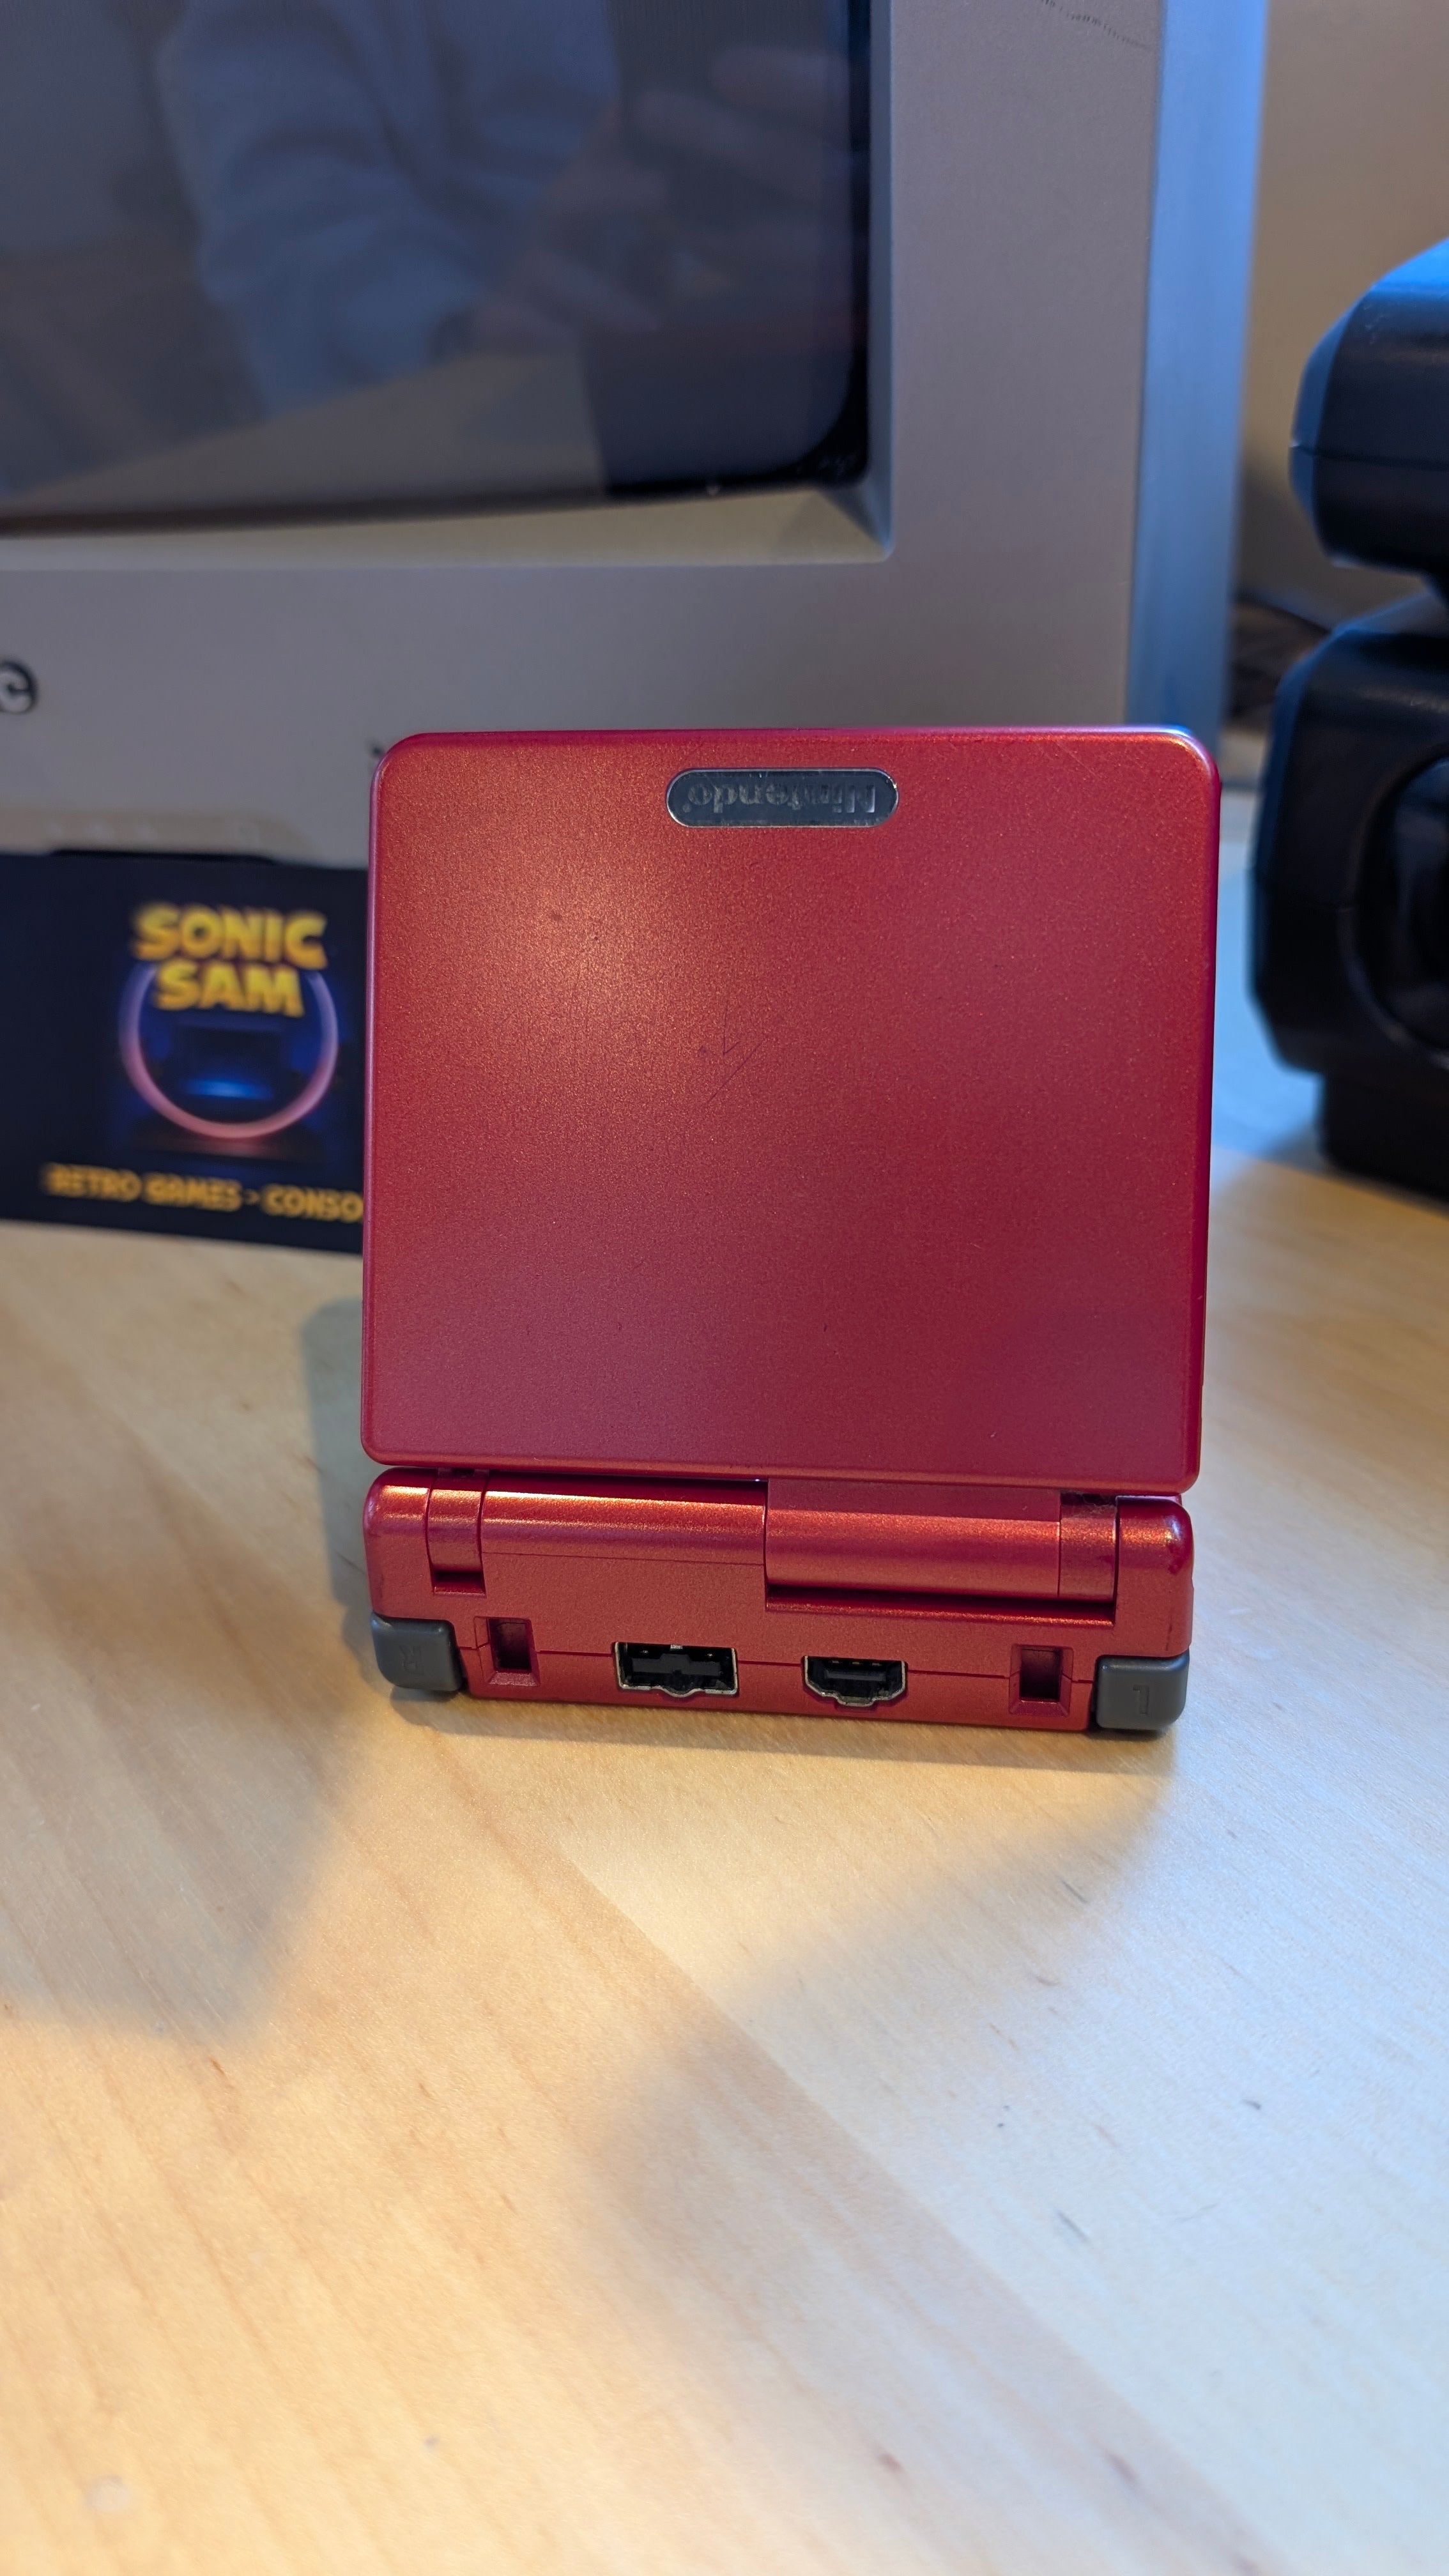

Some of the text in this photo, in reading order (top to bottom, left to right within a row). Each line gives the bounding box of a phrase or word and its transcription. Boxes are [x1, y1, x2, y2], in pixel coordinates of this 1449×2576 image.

[133, 903, 327, 969] SONIC
[154, 960, 304, 1018] SAM
[43, 1163, 142, 1201] RETRO
[144, 1172, 243, 1211] GAMES
[261, 1183, 364, 1223] CONSO
